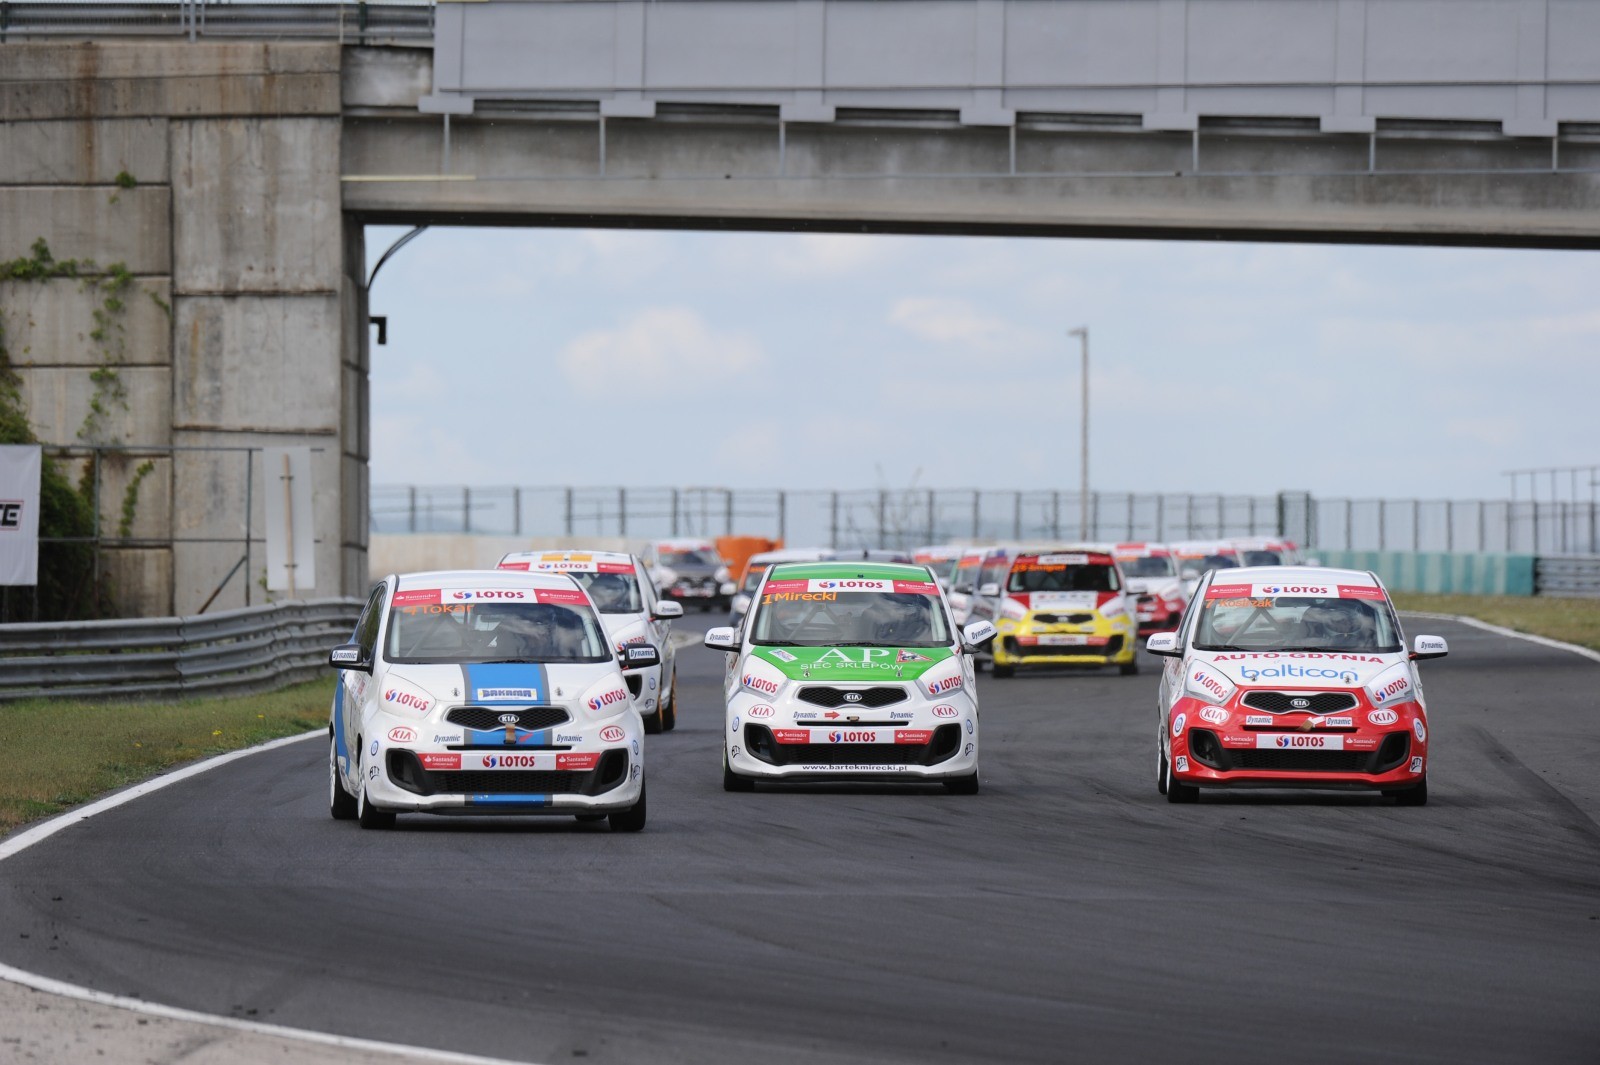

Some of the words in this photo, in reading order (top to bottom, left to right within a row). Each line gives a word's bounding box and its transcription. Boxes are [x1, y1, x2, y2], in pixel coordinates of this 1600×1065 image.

[839, 581, 883, 589] LOTOS
[1283, 586, 1328, 594] LOTOS
[476, 591, 524, 599] LOTOS
[762, 593, 773, 605] 1
[774, 591, 838, 602] Mirecki
[1205, 598, 1216, 609] 7
[420, 604, 476, 614] Tokar
[709, 633, 731, 641] Dynamic
[971, 625, 992, 640] Dynamic
[1420, 641, 1444, 650] Dynamic
[332, 651, 357, 659] Dynamic
[630, 649, 654, 658] Dynamic
[813, 648, 890, 663] AP
[1213, 653, 1384, 664] AUTO-GDYNIA
[836, 662, 903, 671] SKLEPÓW
[1241, 664, 1359, 681] balticon
[751, 677, 778, 693] LOTOS
[939, 675, 962, 691] LOTOS
[1201, 676, 1228, 698] LOTOS
[1383, 677, 1408, 696] LOTOS
[396, 692, 429, 711] LOTOS
[599, 689, 627, 706] LOTOS
[751, 707, 770, 716] KIA
[792, 711, 818, 719] Dynamic
[889, 711, 914, 719] Dynamic
[936, 707, 955, 716] KIA
[1204, 708, 1223, 720] KIA
[1247, 716, 1272, 724] Dynamic
[1327, 717, 1351, 725] Dynamic
[1373, 713, 1394, 722] KIA
[392, 730, 412, 739] KIA
[433, 734, 461, 743] Dynamic
[556, 734, 582, 743] Dynamic
[604, 730, 624, 739] KIA
[843, 732, 876, 742] LOTOS
[1291, 736, 1324, 747] LOTOS
[499, 755, 535, 768] LOTOS
[802, 764, 908, 772] www.bartekmirecki.pl
